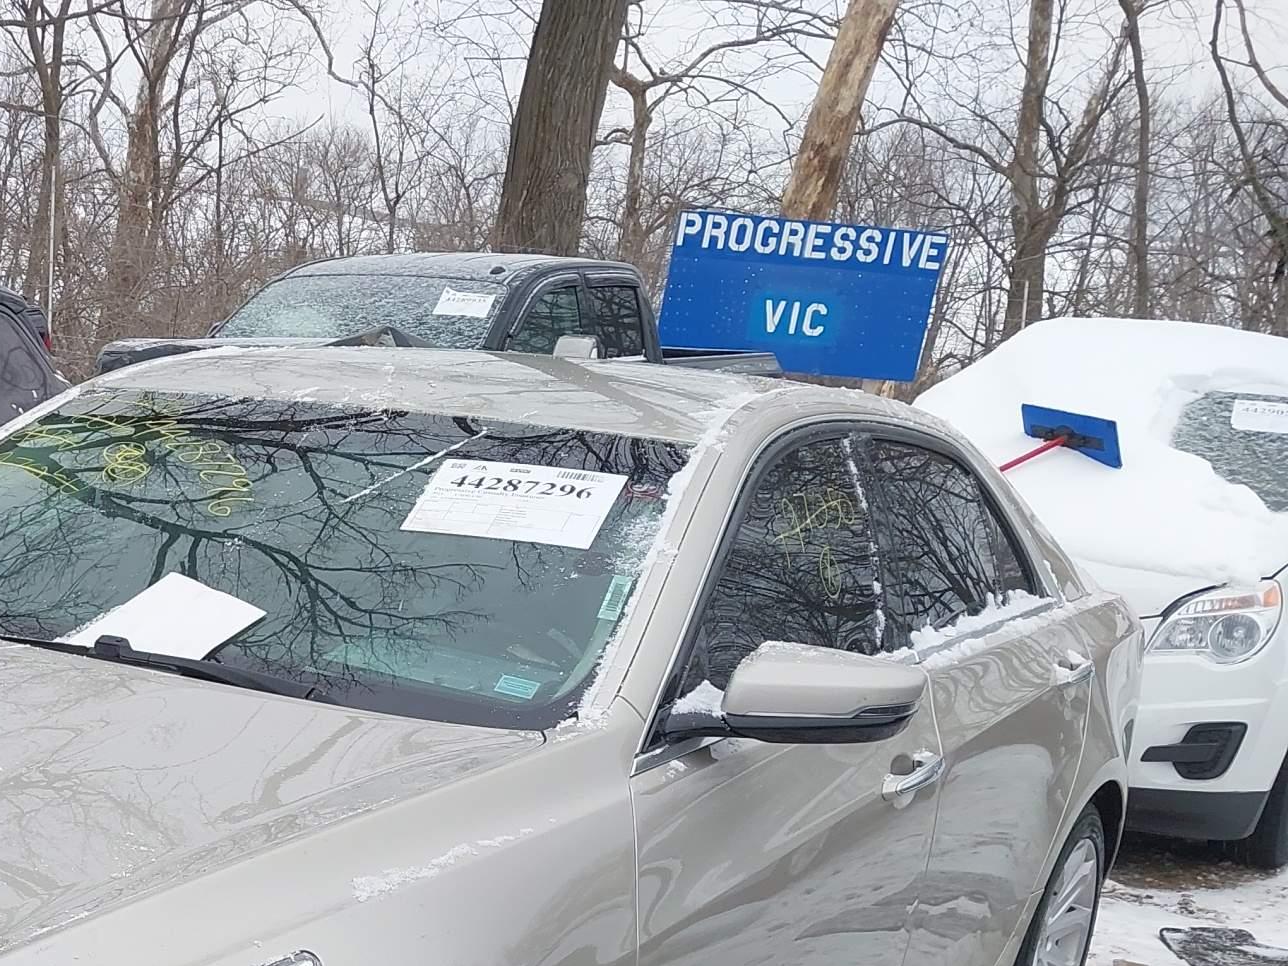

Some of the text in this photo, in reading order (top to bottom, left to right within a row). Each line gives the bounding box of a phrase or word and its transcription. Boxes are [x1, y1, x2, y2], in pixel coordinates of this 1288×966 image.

[676, 211, 948, 271] PROGRESSIVE
[765, 299, 829, 337] VIC
[450, 474, 596, 500] 44287296
